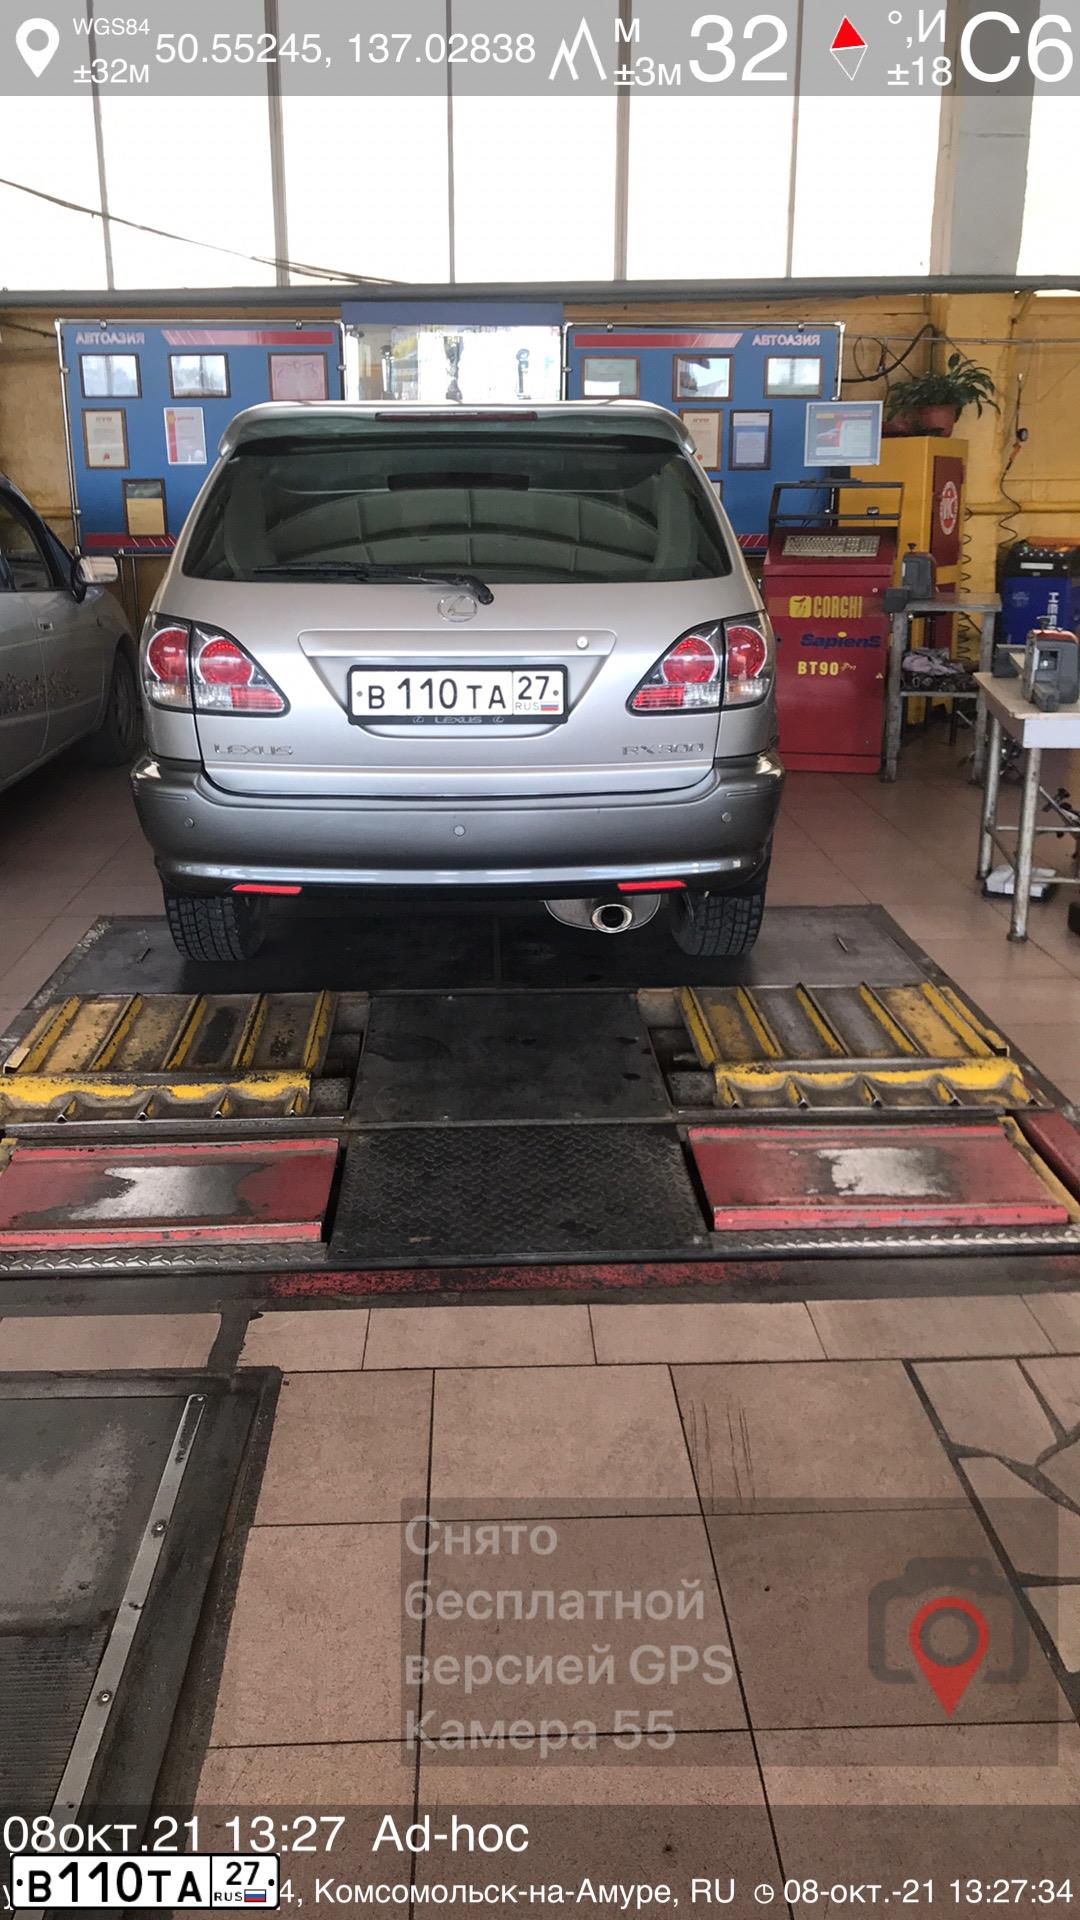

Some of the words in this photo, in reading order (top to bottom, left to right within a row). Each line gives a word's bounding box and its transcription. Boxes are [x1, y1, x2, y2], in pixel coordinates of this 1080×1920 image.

[752, 333, 821, 346] АВТОАЗИЯ
[798, 661, 839, 676] BT90
[518, 676, 549, 700] 27
[515, 702, 540, 711] RUS
[213, 744, 294, 755] LEXUS
